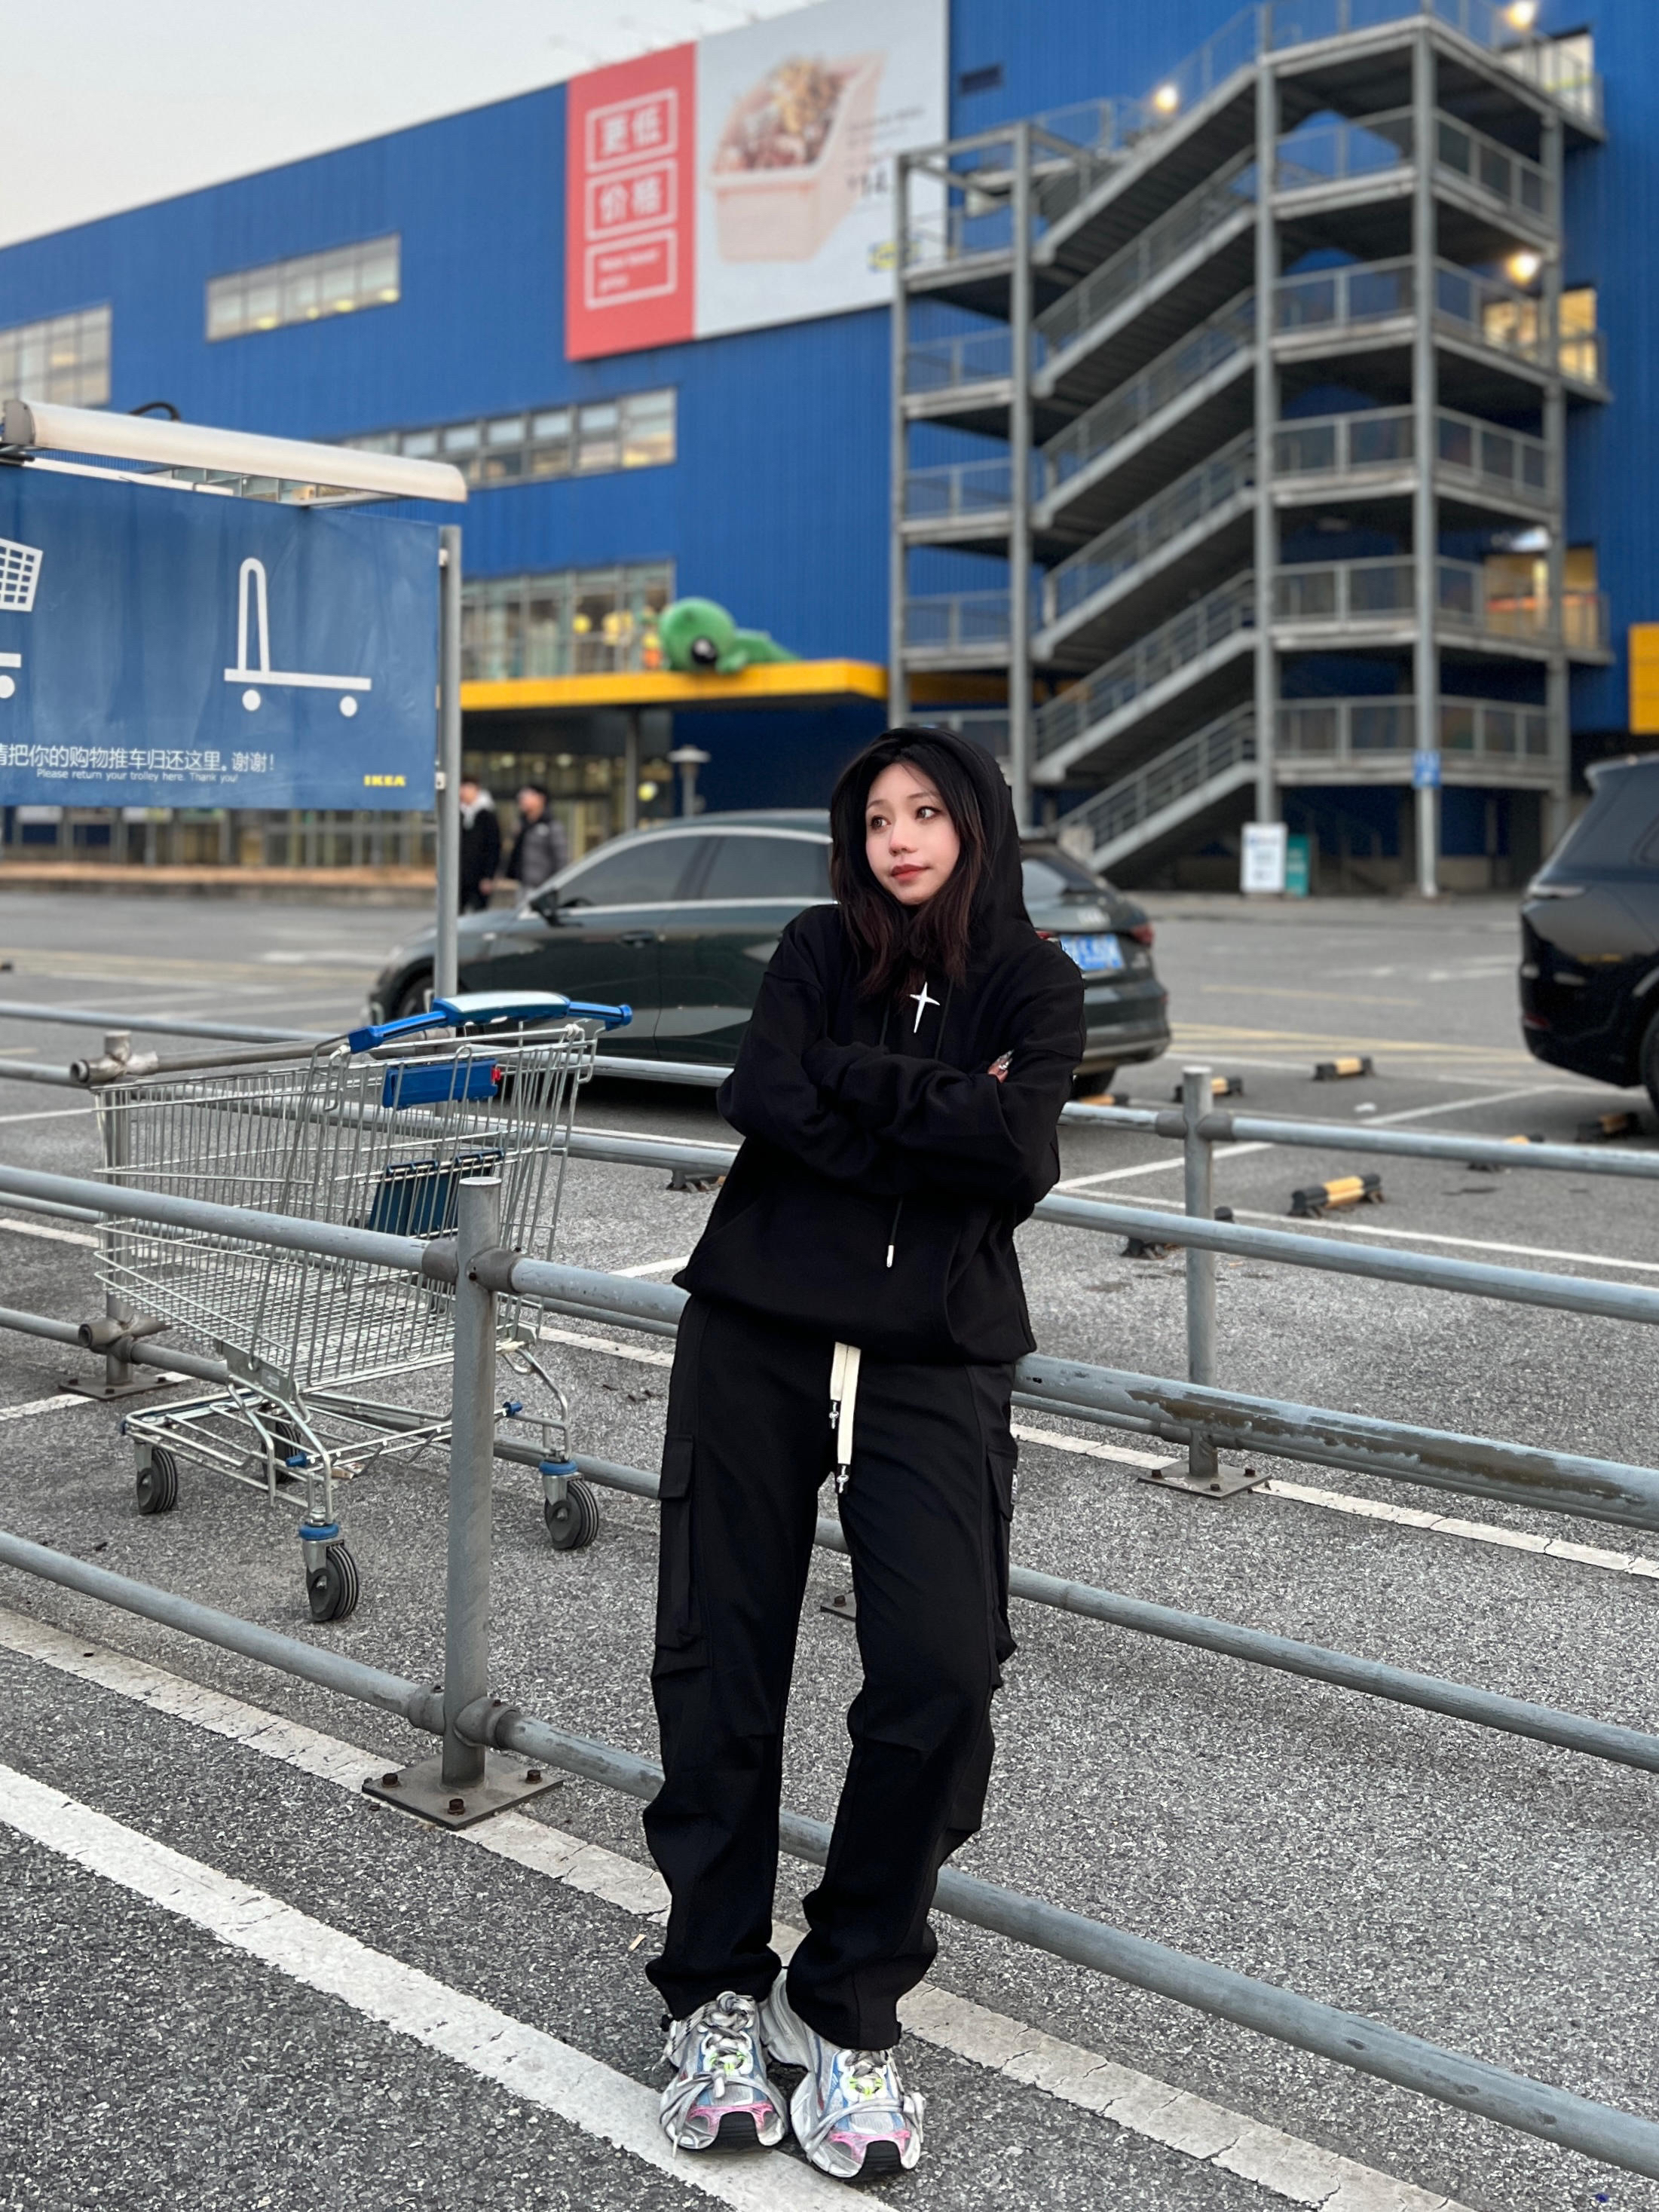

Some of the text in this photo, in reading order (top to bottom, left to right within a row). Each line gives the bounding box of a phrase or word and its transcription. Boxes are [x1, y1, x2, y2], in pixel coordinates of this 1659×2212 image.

[36, 768, 69, 779] Please
[72, 769, 102, 779] return
[106, 772, 127, 782] your
[130, 771, 158, 782] trolley
[189, 772, 216, 782] Thank
[219, 773, 238, 784] you!
[363, 775, 406, 787] IKEA
